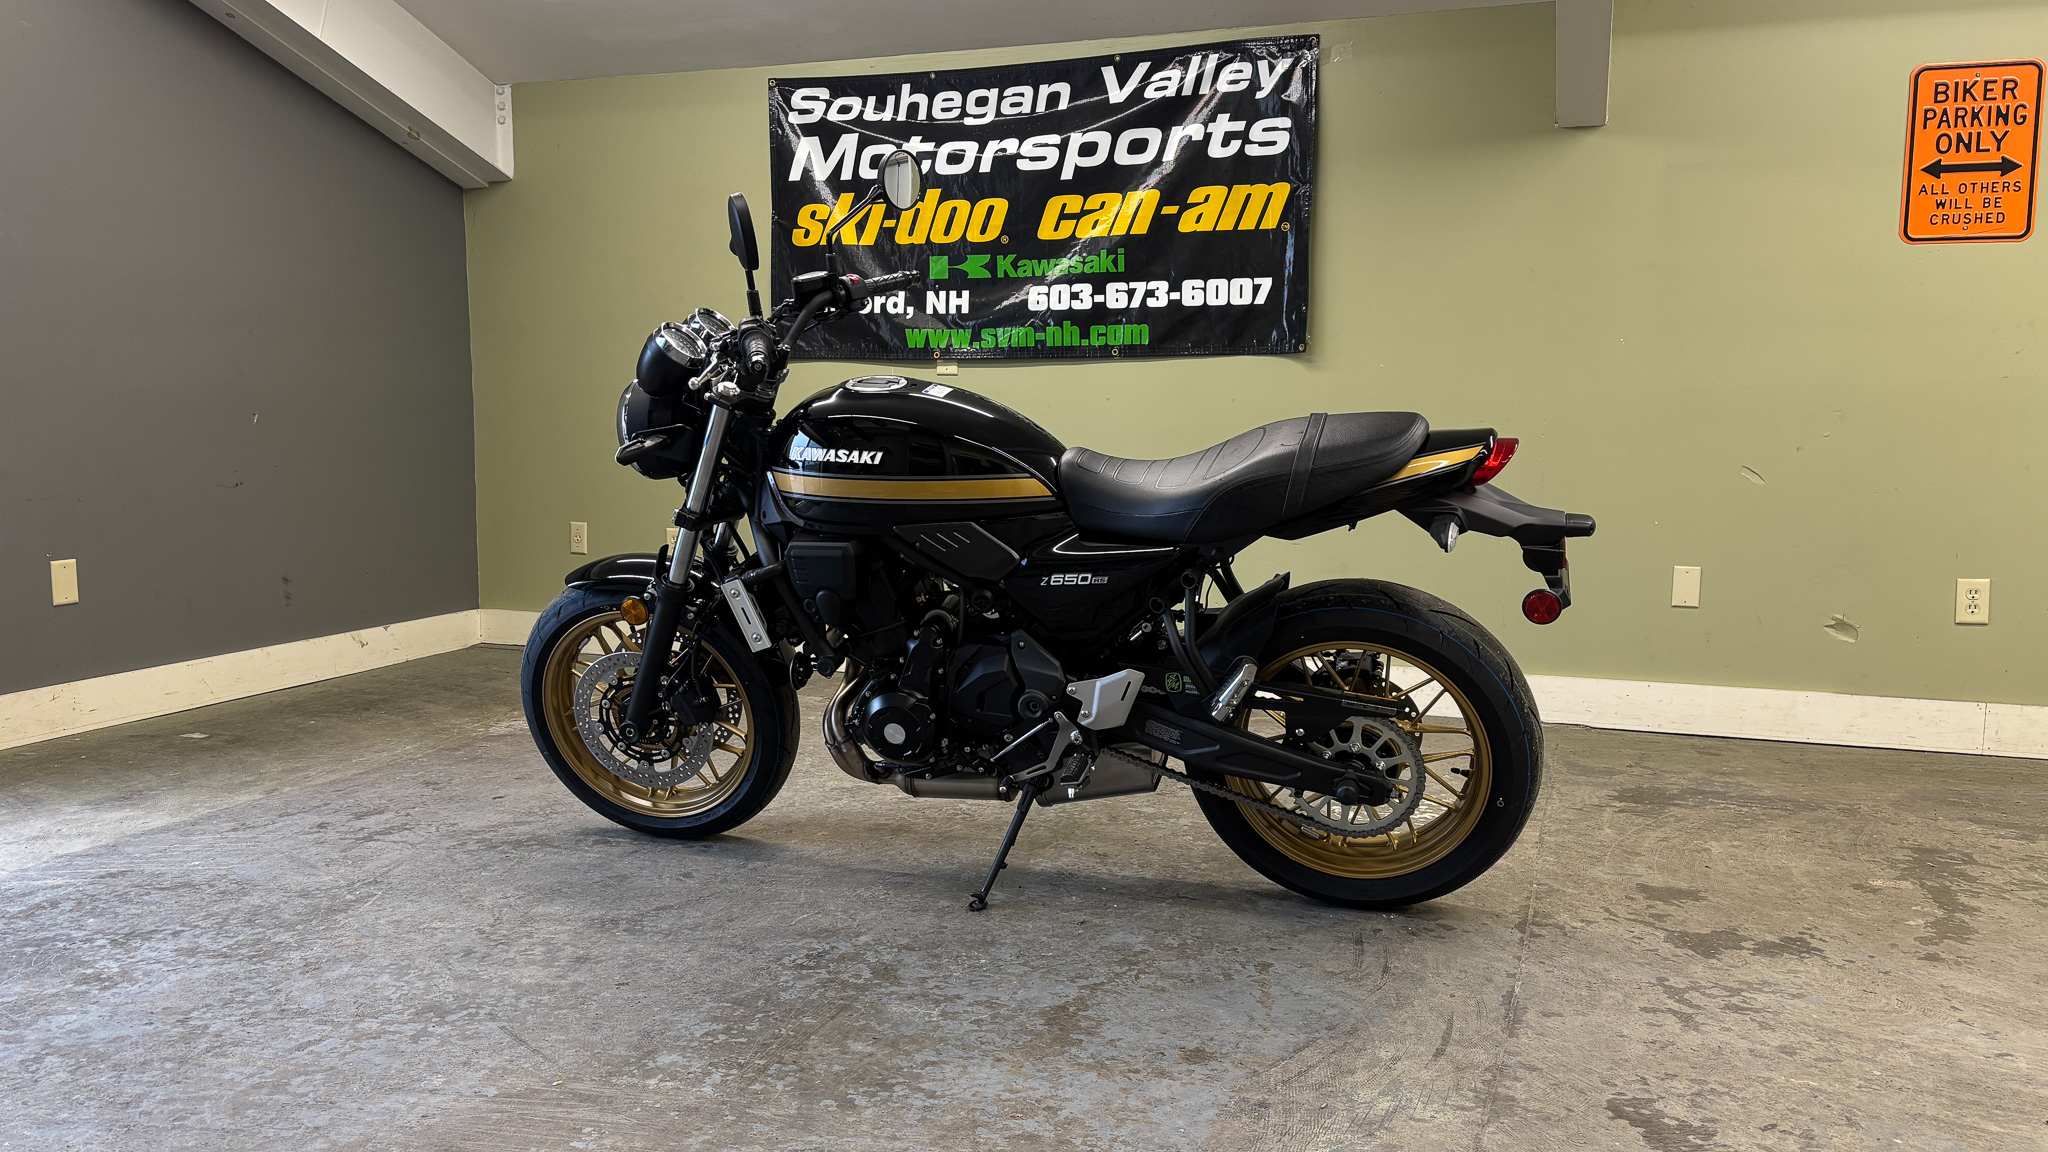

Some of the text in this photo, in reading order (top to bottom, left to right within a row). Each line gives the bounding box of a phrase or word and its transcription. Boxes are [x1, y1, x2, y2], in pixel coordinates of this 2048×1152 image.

[788, 52, 1294, 126] Souhegan Valley
[1934, 78, 2019, 103] BIKER
[1923, 103, 2028, 130] PARKING
[788, 113, 1292, 182] Motorsports
[1936, 130, 2010, 154] ONLY
[1918, 181, 2022, 196] ALL OTHERS
[1037, 182, 1291, 240] can-am
[1935, 197, 2003, 210] WILL BE
[1929, 212, 2005, 225] CRUSHED
[997, 248, 1125, 278] Kawasaki
[926, 290, 970, 315] NH
[1027, 277, 1273, 311] 603-673-6007
[905, 321, 1149, 349] www.svm-nh.com
[790, 446, 884, 465] KAWASAKI
